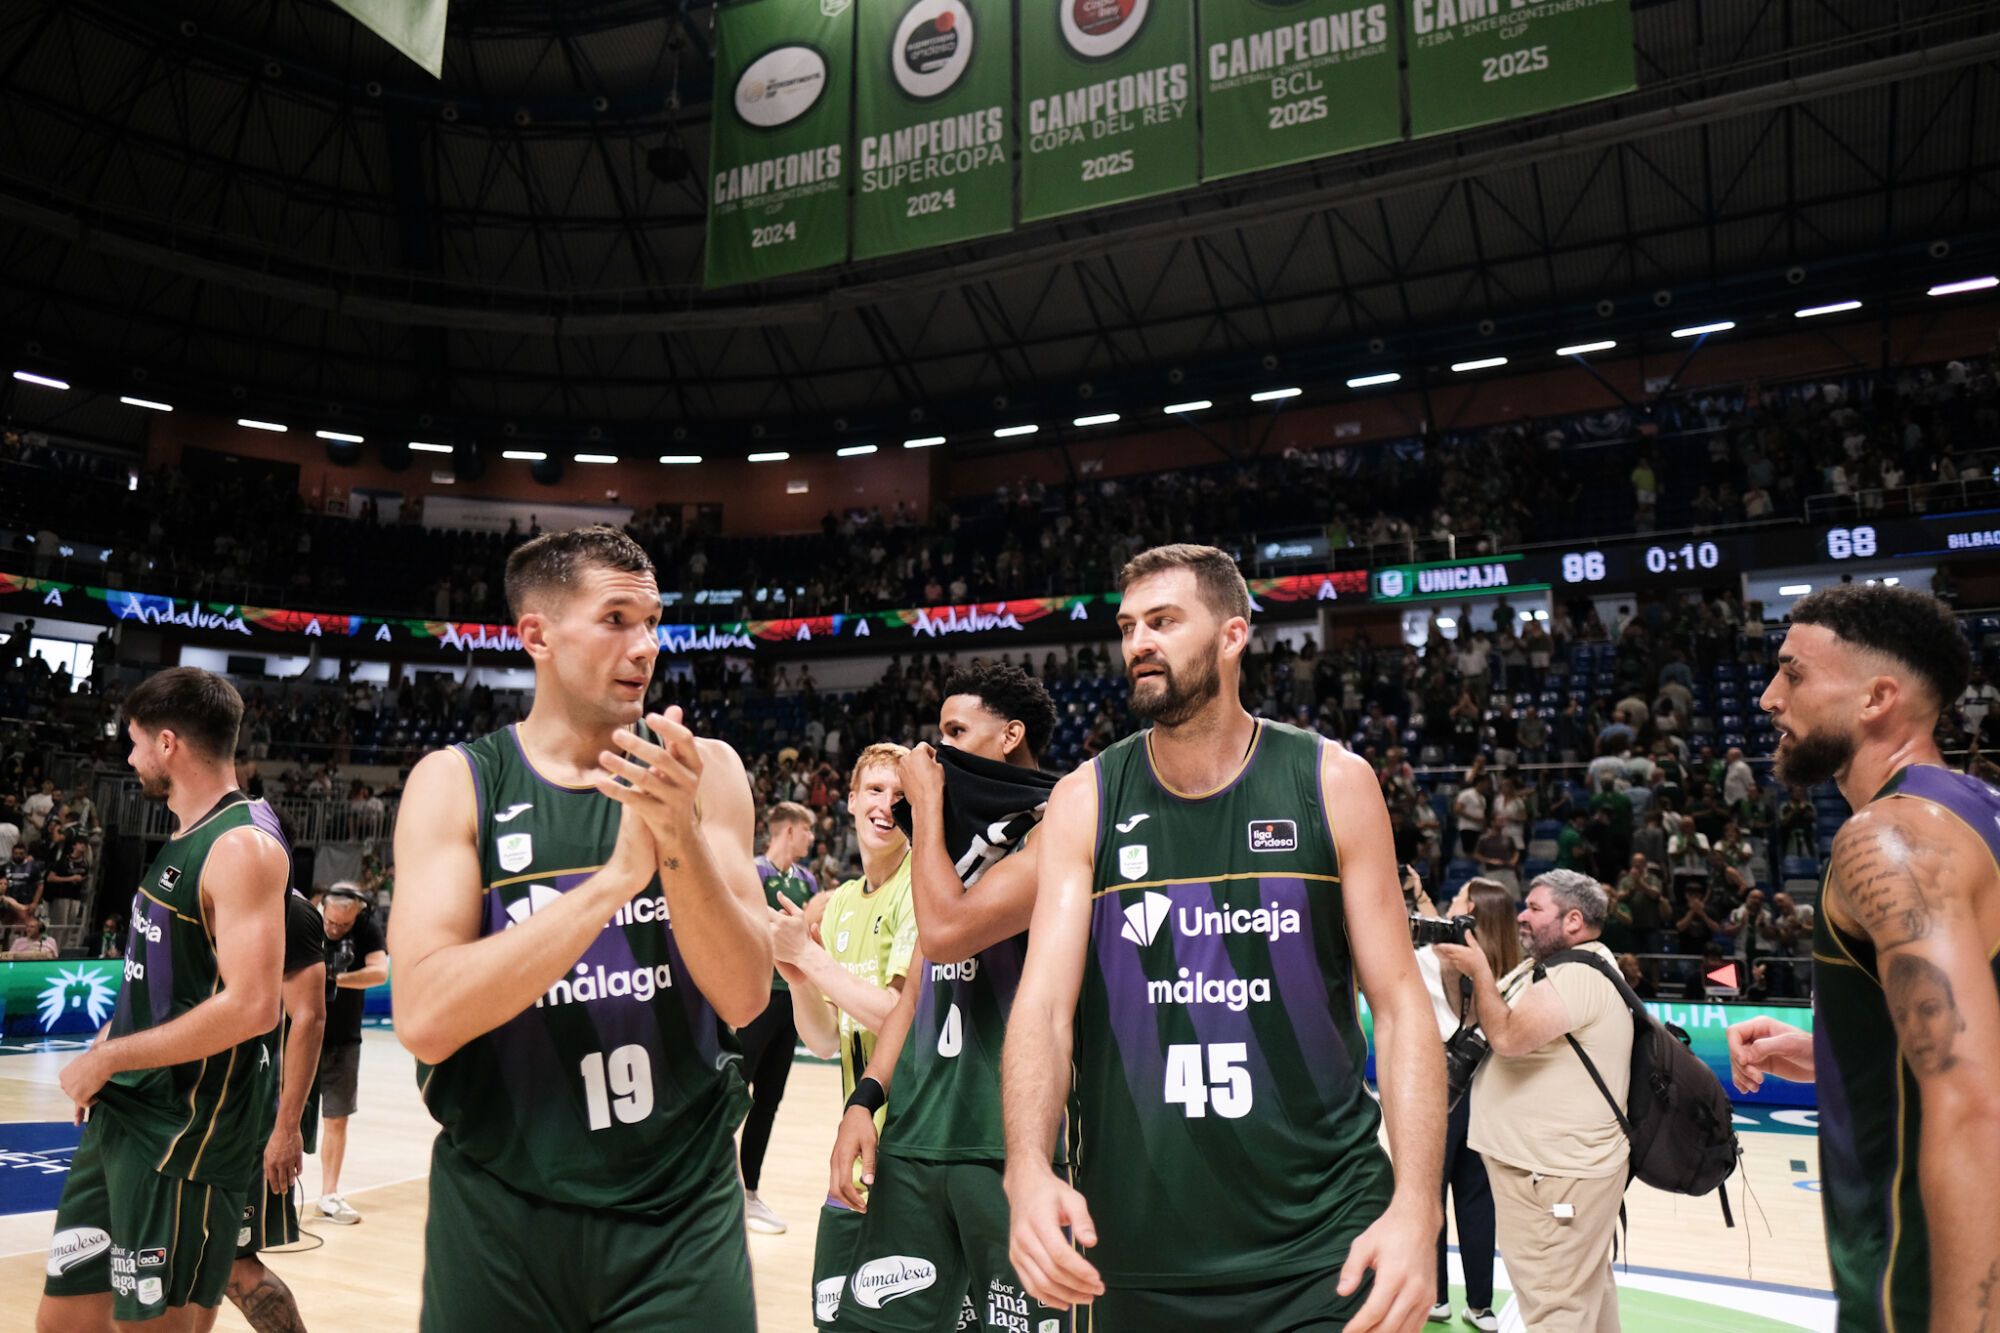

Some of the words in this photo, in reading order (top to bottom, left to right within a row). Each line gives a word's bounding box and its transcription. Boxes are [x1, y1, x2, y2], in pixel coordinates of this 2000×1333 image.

[1208, 3, 1387, 81] CAMPEONES
[1417, 30, 1454, 48] FIBA
[1500, 23, 1528, 40] CUP
[1482, 45, 1549, 82] 2025
[1029, 63, 1188, 135] CAMPEONES
[1271, 71, 1323, 99] BCL
[1030, 126, 1085, 153] COPA
[1092, 114, 1134, 139] DEL
[1143, 100, 1187, 126] REY
[1269, 95, 1328, 130] 2025
[861, 106, 1003, 170] CAMPEONES
[714, 144, 842, 204] CAMPEONES
[862, 143, 1005, 192] SUPERCOPA
[1081, 150, 1134, 182] 2025
[907, 188, 956, 217] 2024
[751, 221, 797, 248] 2024
[1646, 542, 1719, 573] 0:10
[1827, 525, 1877, 559] 68
[1418, 564, 1508, 592] UNICAJA
[1562, 551, 1606, 583] 86
[121, 592, 253, 635] Andalucía
[912, 601, 1024, 637] Andalucía
[1253, 830, 1272, 840] liga
[1254, 838, 1293, 848] endesa
[1179, 902, 1300, 941] Unicaja
[1148, 967, 1271, 1011] málaga
[580, 1043, 654, 1131] 19
[1164, 1042, 1253, 1118] 45
[111, 1244, 125, 1256] abor
[140, 1254, 160, 1265] acb
[995, 1291, 1030, 1316] má
